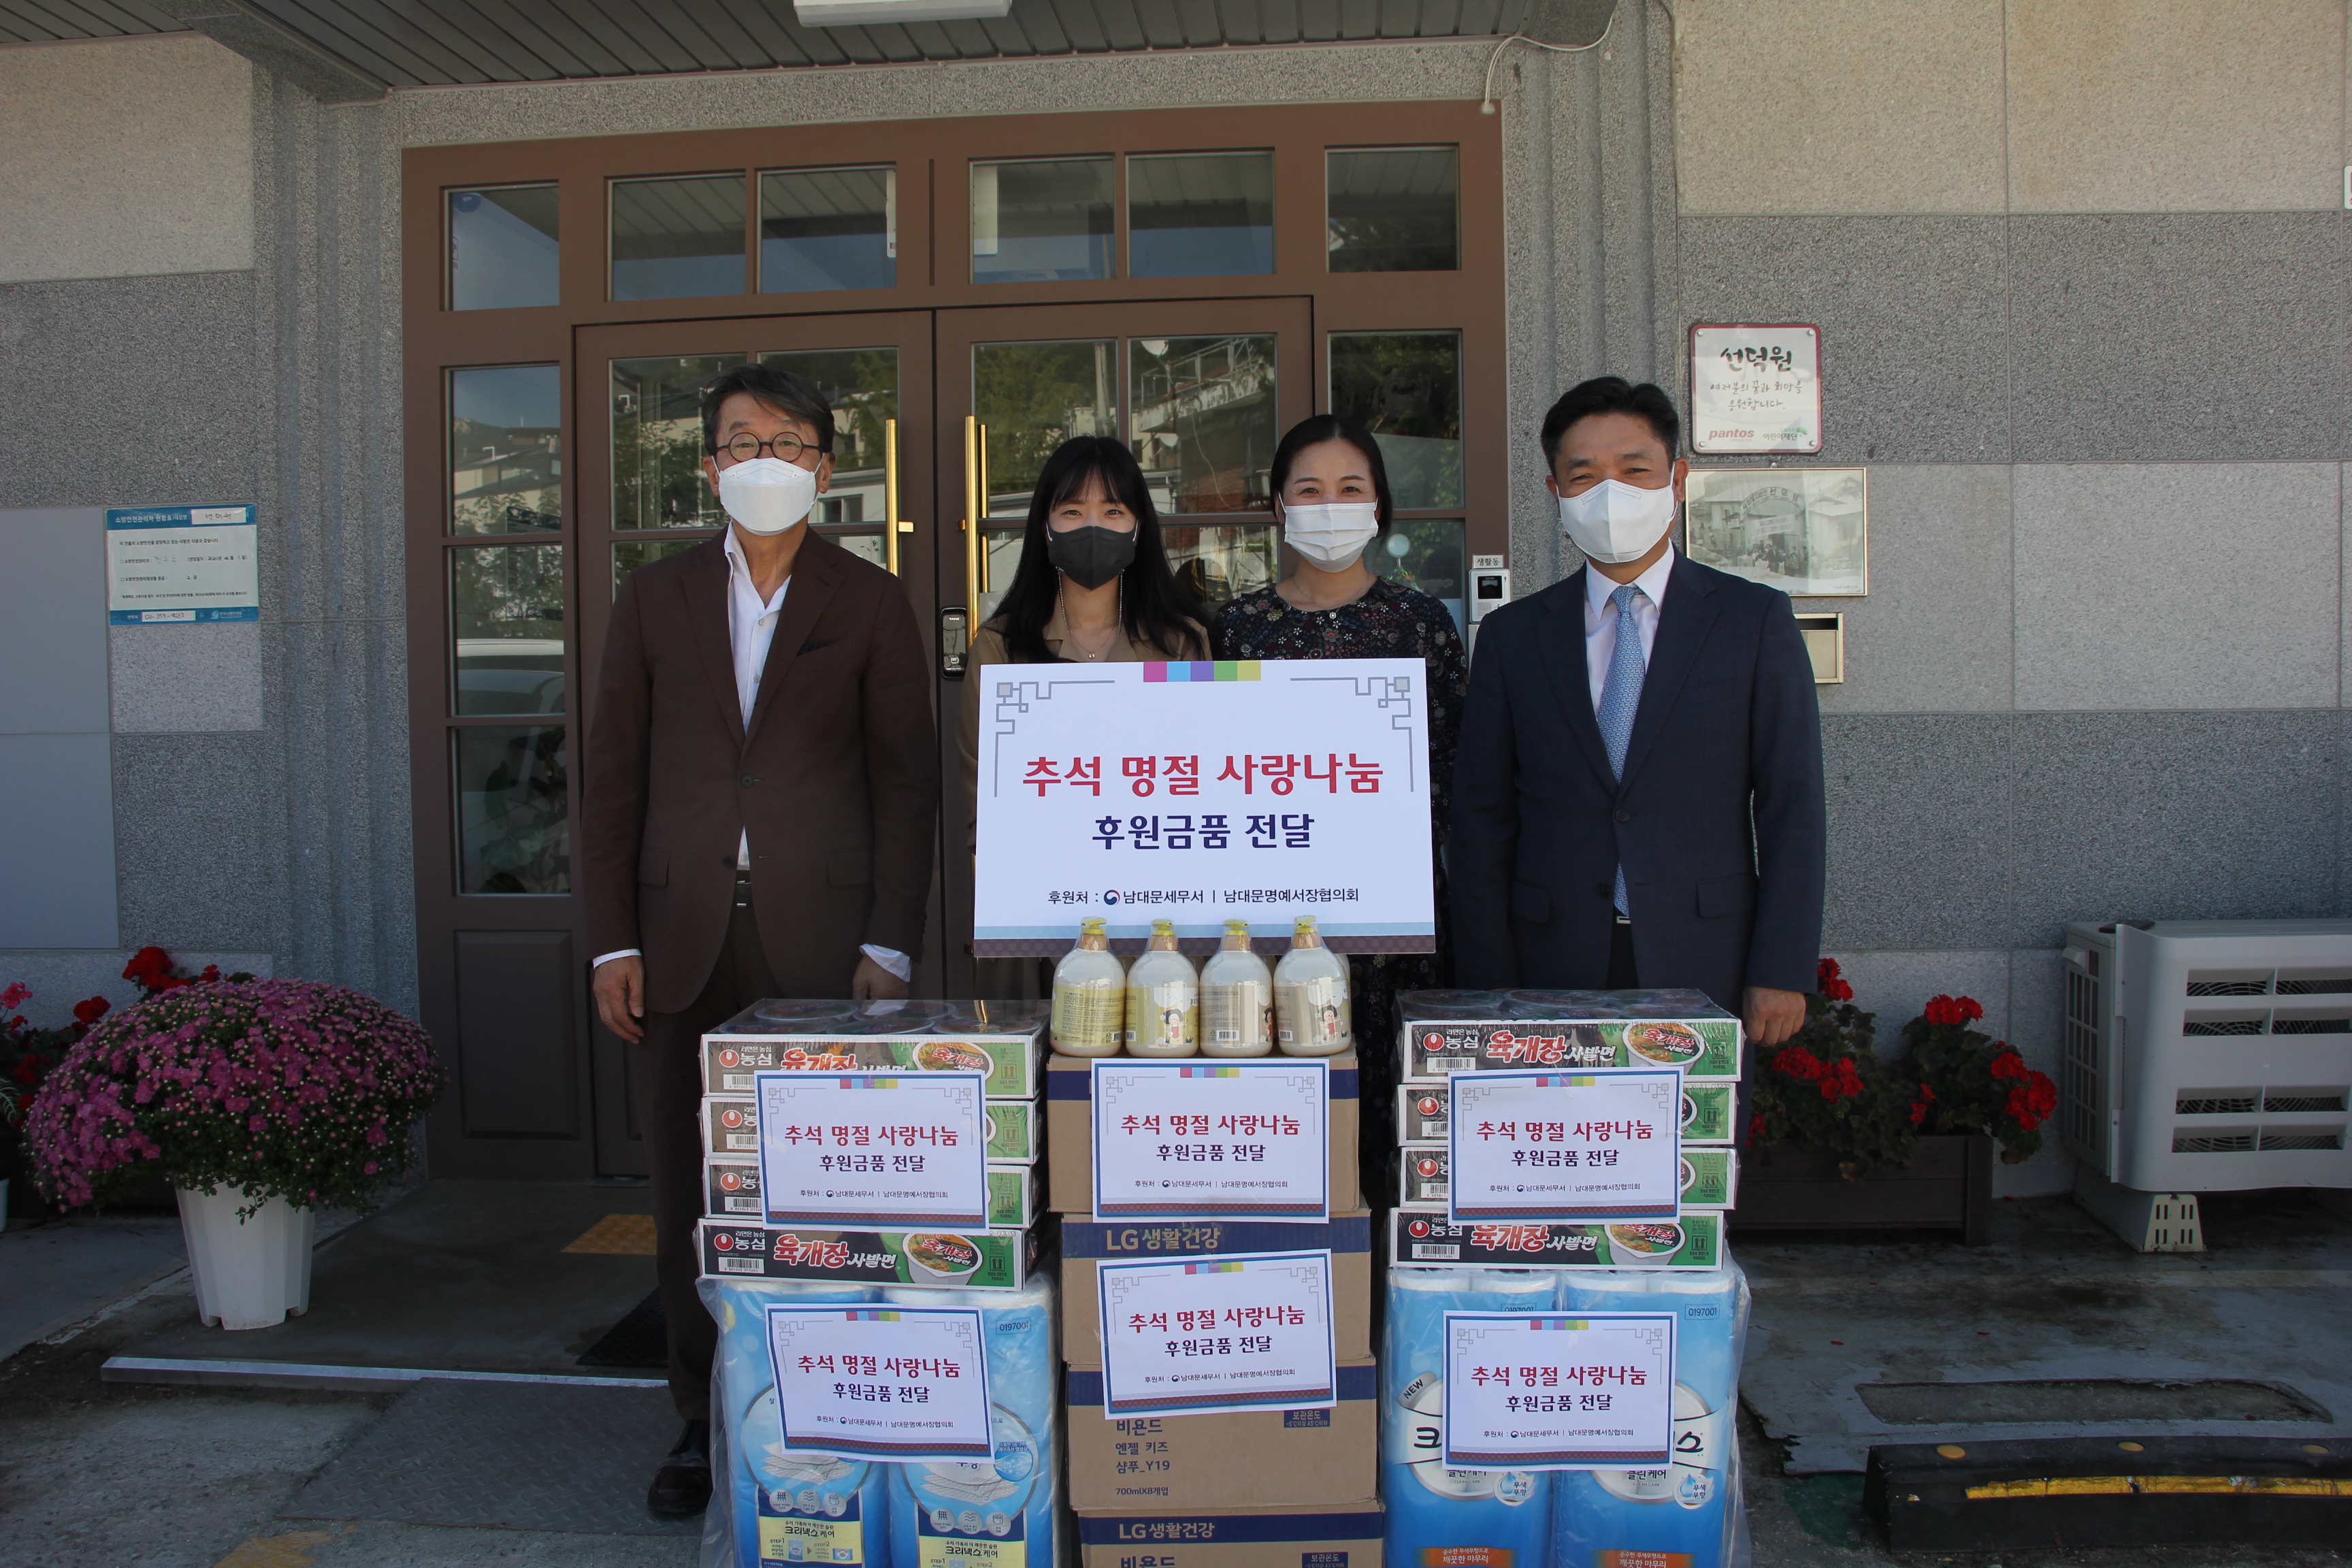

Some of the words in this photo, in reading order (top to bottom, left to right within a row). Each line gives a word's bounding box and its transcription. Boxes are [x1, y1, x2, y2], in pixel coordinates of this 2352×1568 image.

[1720, 346, 1793, 373] 선덕원
[1710, 381, 1748, 395] 여러분의
[1752, 380, 1770, 395] 꿈과
[1775, 380, 1803, 394] 희망을
[1728, 398, 1785, 412] 응원합니다.
[1708, 428, 1754, 440] pantos
[1763, 433, 1797, 441] 어린이재단
[115, 515, 154, 523] 소방안전관리자
[1477, 558, 1499, 566] 생활동
[1023, 757, 1100, 796] 추석
[1122, 755, 1198, 797] 명절
[1217, 753, 1383, 796] 사랑나눔
[1092, 815, 1230, 849] 후원금품
[1245, 814, 1314, 848] 전달
[1048, 892, 1088, 904] 후원처
[1124, 890, 1203, 904] 남대문세무서
[1224, 889, 1358, 902] 남대문명예서장협의회
[1446, 1036, 1478, 1049] 농심
[1643, 1028, 1695, 1047] 육개장
[1486, 1030, 1567, 1064] 육개장
[740, 1053, 772, 1066] 농심
[932, 1047, 983, 1067] 육개장
[1121, 1115, 1160, 1134] 추석
[1171, 1115, 1209, 1135] 명절
[1218, 1115, 1300, 1135] 사랑나눔
[1477, 1122, 1515, 1141] 추석
[1526, 1122, 1563, 1141] 명절
[1573, 1120, 1653, 1141] 사랑나눔
[785, 1126, 821, 1145] 추석
[832, 1126, 869, 1146] 명절
[878, 1126, 958, 1146] 사랑나눔
[1156, 1145, 1224, 1161] 후원금품
[1232, 1145, 1265, 1161] 전달
[1512, 1150, 1578, 1166] 후원금품
[1586, 1149, 1619, 1166] 전달
[819, 1155, 885, 1171] 후원금품
[892, 1156, 925, 1172] 전달
[1575, 1183, 1639, 1192] 남대문명예서장협의회
[1431, 1224, 1463, 1237] 농심
[735, 1237, 766, 1250] 농심
[1470, 1225, 1550, 1252] 육개장
[774, 1234, 849, 1269] 육개장
[921, 1239, 973, 1258] 육개장
[1688, 1307, 1717, 1316] 0197001
[999, 1321, 1028, 1331] 0197001
[1129, 1313, 1167, 1333] 추석
[1177, 1309, 1215, 1331] 명절
[1224, 1305, 1305, 1327] 사랑나눔
[1165, 1338, 1231, 1357] 후원금품
[1239, 1336, 1272, 1353] 전달
[798, 1356, 834, 1373] 추석
[843, 1356, 877, 1375] 명절
[884, 1358, 960, 1378] 사랑나눔
[1230, 1369, 1294, 1379] 남대문명예서장협의회
[1471, 1367, 1509, 1386] 추석
[1520, 1367, 1557, 1387] 명절
[1567, 1366, 1647, 1386] 사랑나눔
[833, 1383, 892, 1402] 후원금품
[898, 1387, 930, 1403] 전달
[1403, 1379, 1424, 1399] NEW
[1505, 1396, 1572, 1412] 후원금품
[1580, 1394, 1612, 1410] 전달
[848, 1418, 882, 1426] 남대문세무서
[1292, 1410, 1320, 1420] 보관온도
[1117, 1419, 1163, 1436] 비욘드
[1115, 1442, 1139, 1455] 엔젤
[1145, 1441, 1169, 1454] 키즈
[1116, 1460, 1170, 1473] 샴푸_Y19
[777, 1491, 787, 1501] 無
[1115, 1487, 1168, 1496] 700mlX8개입
[938, 1510, 948, 1520] 無
[785, 1526, 819, 1537] 크리넥스
[945, 1546, 981, 1556] 크리넥스
[1311, 1553, 1339, 1563] 보관온도
[1443, 1555, 1465, 1564] 깨끗한
[1467, 1555, 1488, 1563] 마무리
[1619, 1559, 1643, 1568] 깨끗한
